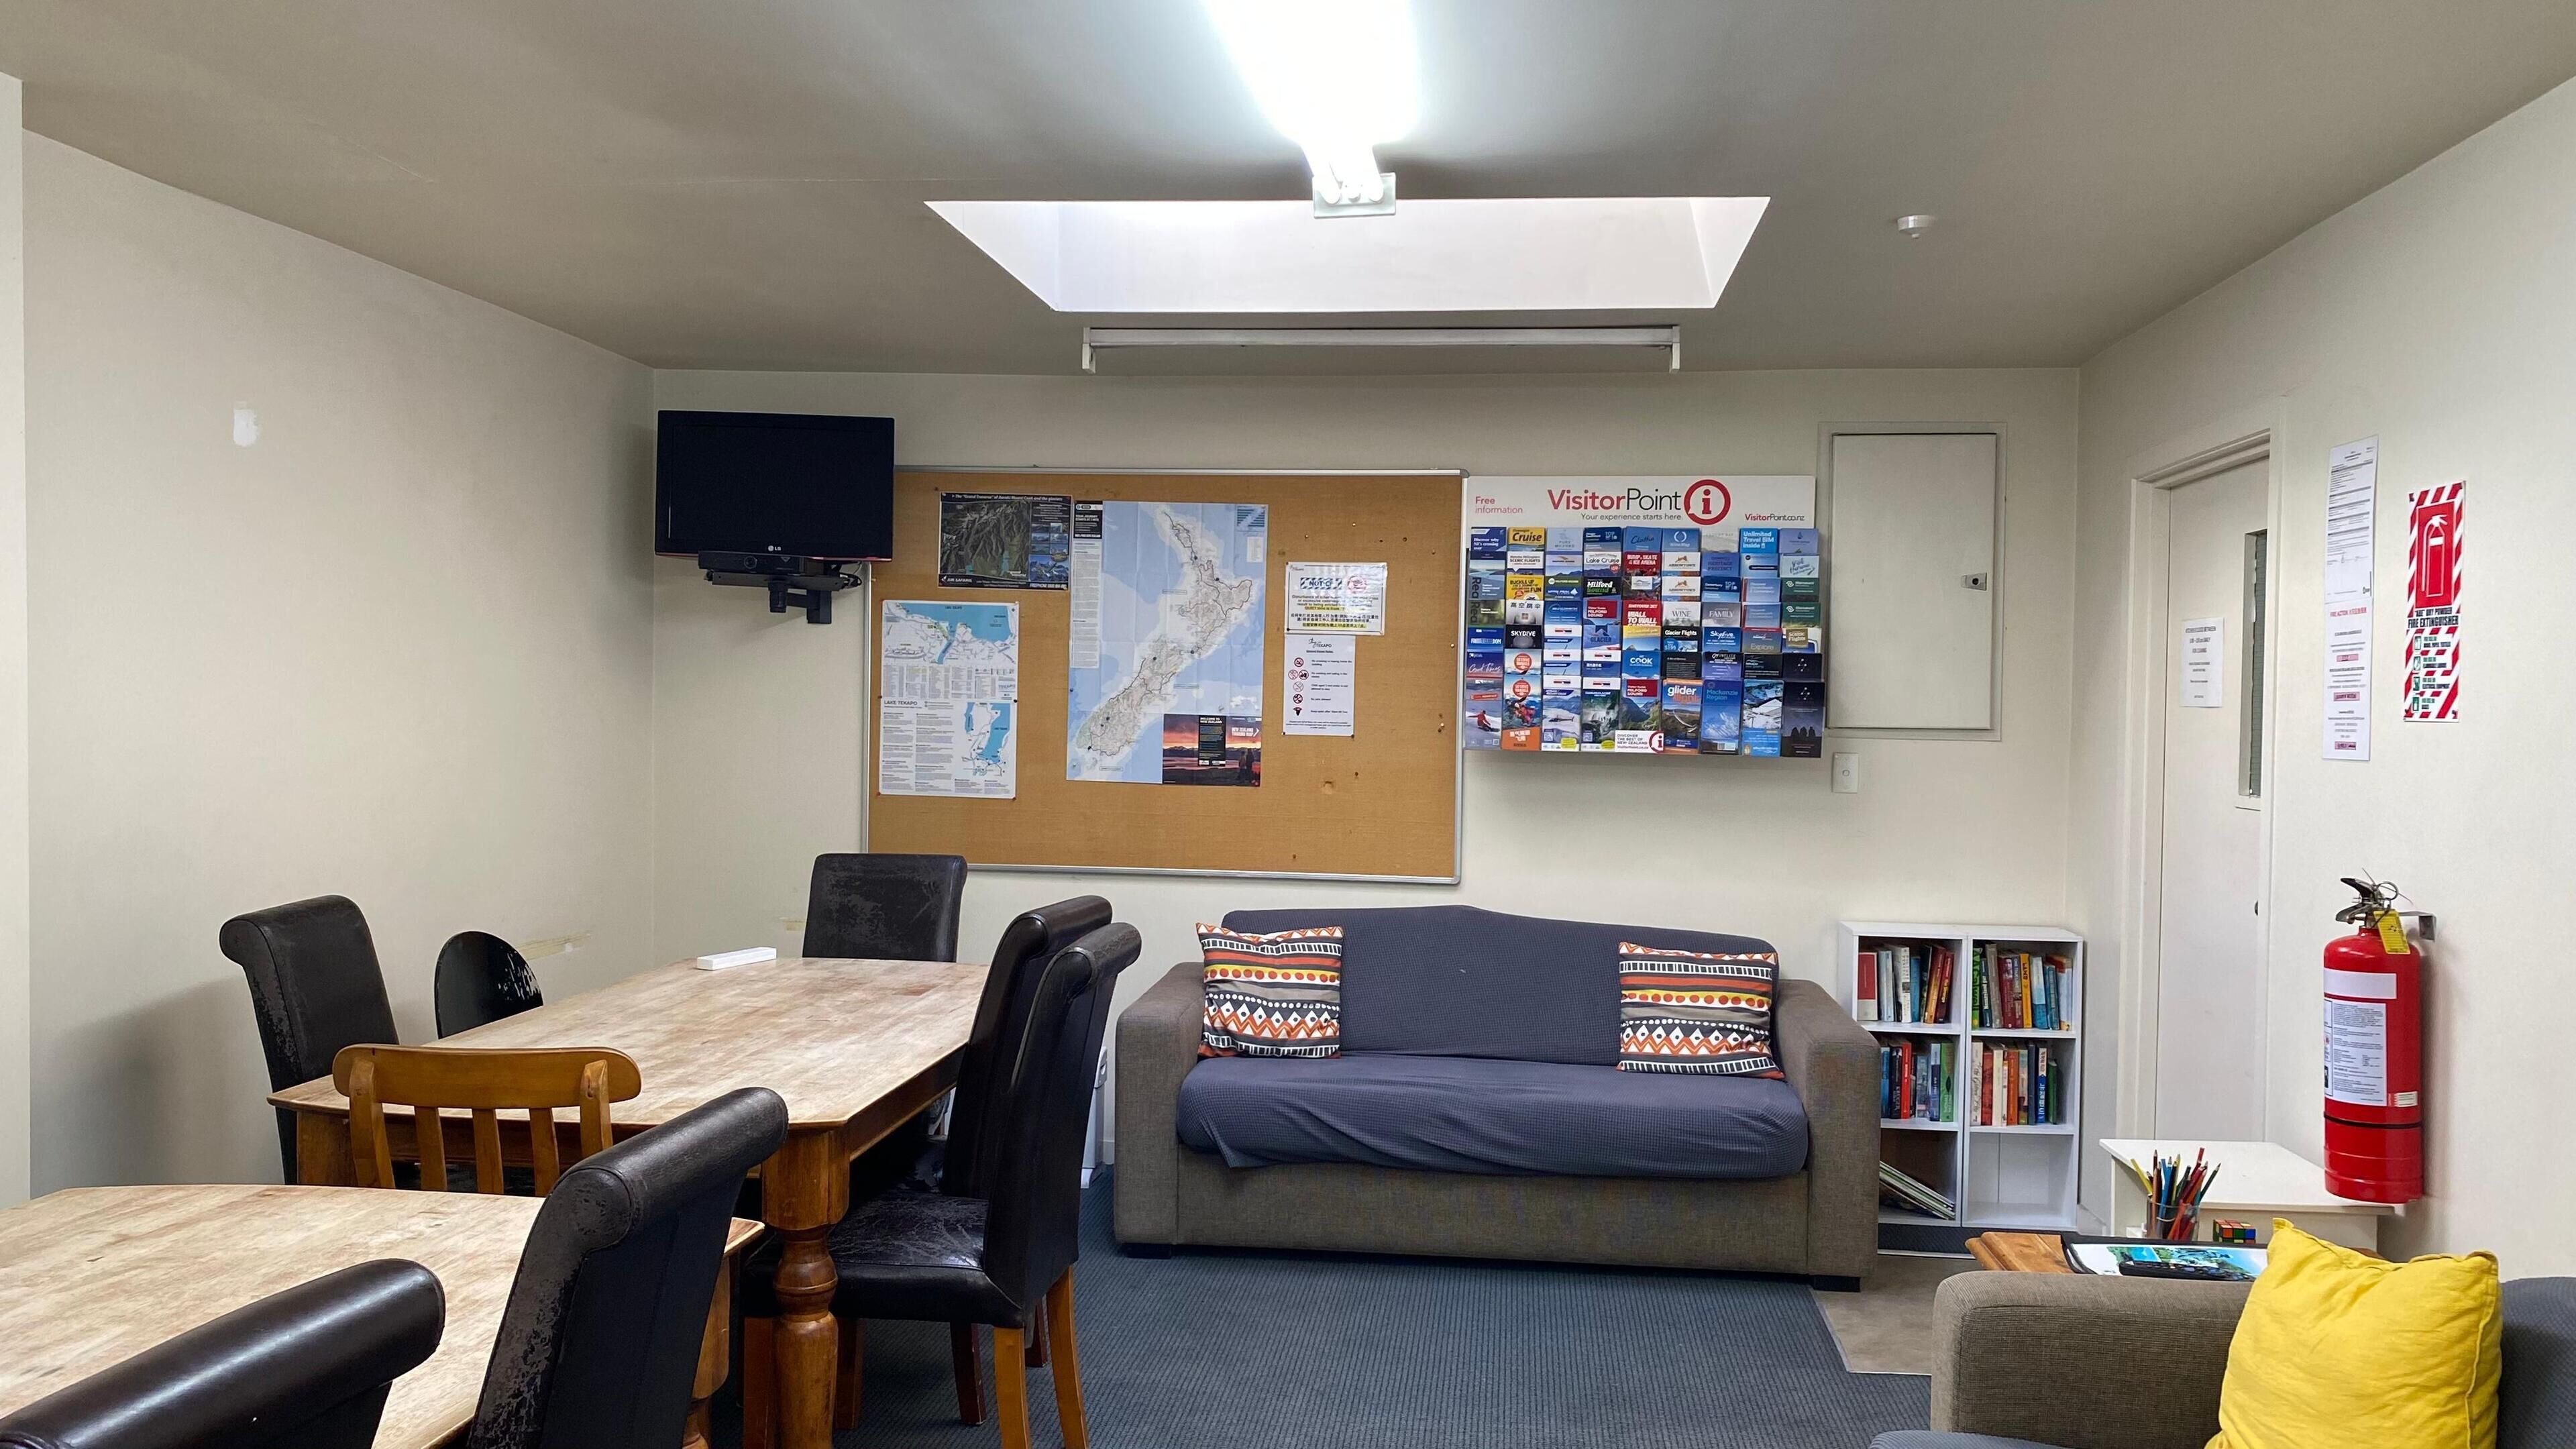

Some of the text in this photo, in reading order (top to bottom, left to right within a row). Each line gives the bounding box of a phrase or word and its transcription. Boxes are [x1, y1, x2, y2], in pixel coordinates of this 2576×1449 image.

[1475, 496, 1495, 504] Free
[1548, 488, 1682, 511] VisitorPoint
[1475, 506, 1523, 514] information
[1599, 513, 1641, 521] experience
[1745, 513, 1805, 521] VisitorPoint.co.nz
[1512, 532, 1542, 542] Cruise
[2408, 615, 2459, 629] FIRE EXTINGUISHER
[1710, 631, 1733, 639] Skydive
[1667, 686, 1697, 696] glider
